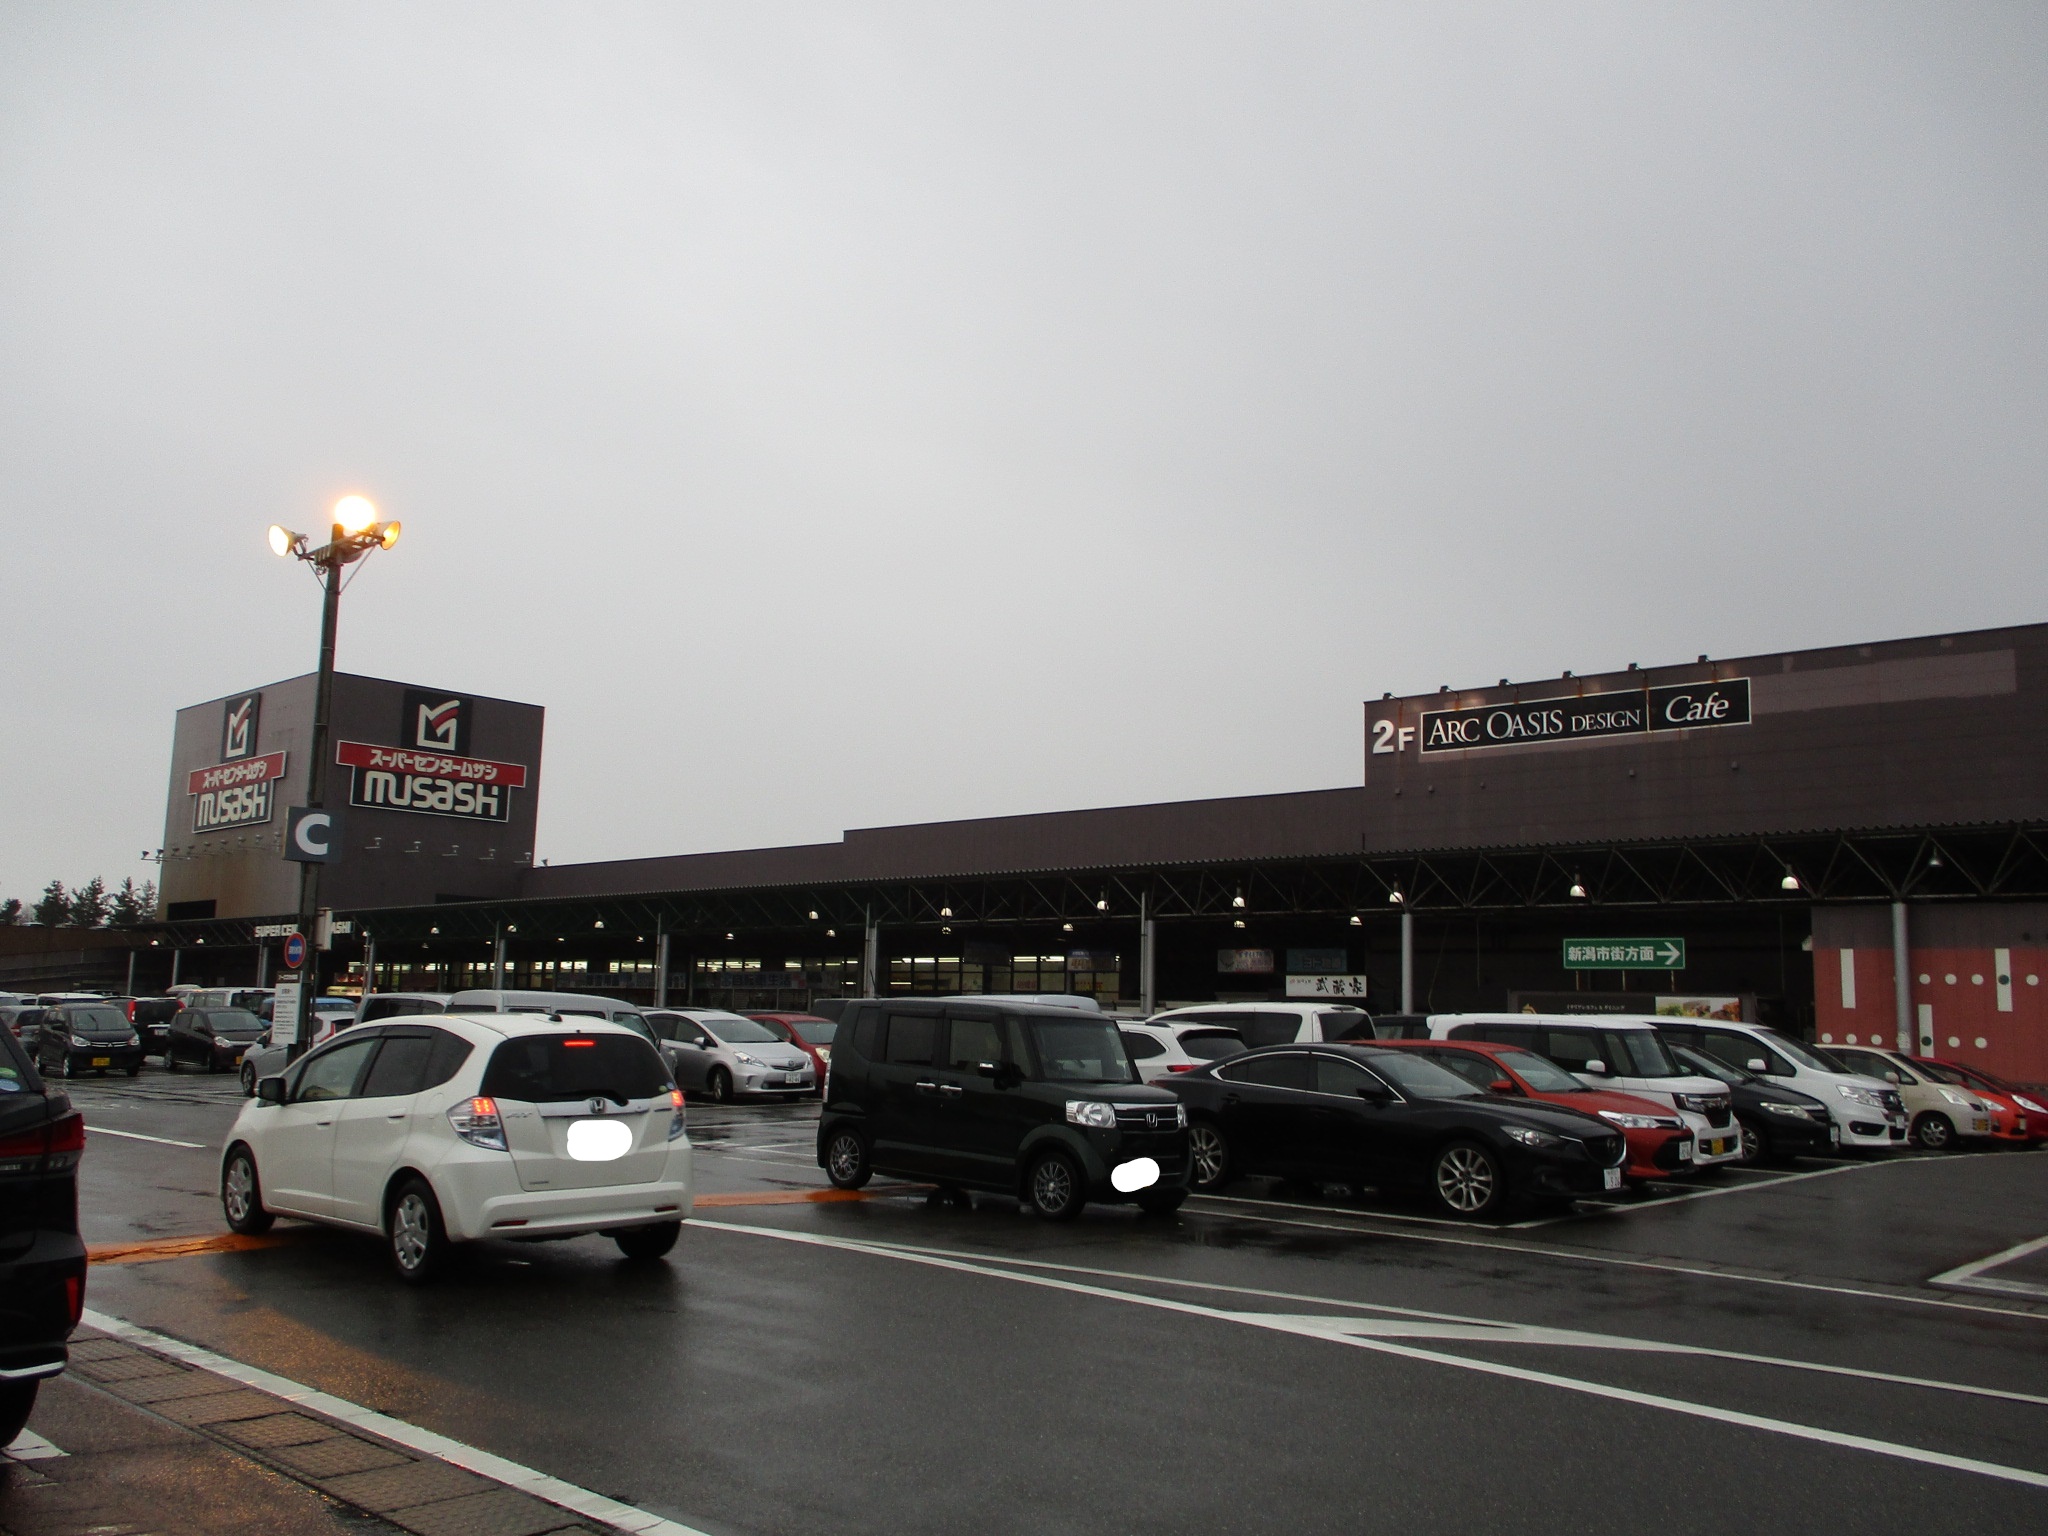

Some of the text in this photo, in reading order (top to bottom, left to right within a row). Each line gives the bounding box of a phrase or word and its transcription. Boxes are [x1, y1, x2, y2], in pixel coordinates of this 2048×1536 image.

[1665, 691, 1729, 723] Cafe
[1372, 719, 1415, 754] 2F
[1427, 709, 1640, 746] ARC OASIS DESIGN
[369, 749, 497, 781] スーパーセンタームサシ
[295, 813, 330, 855] C
[1567, 945, 1655, 963] 新潟市街方面
